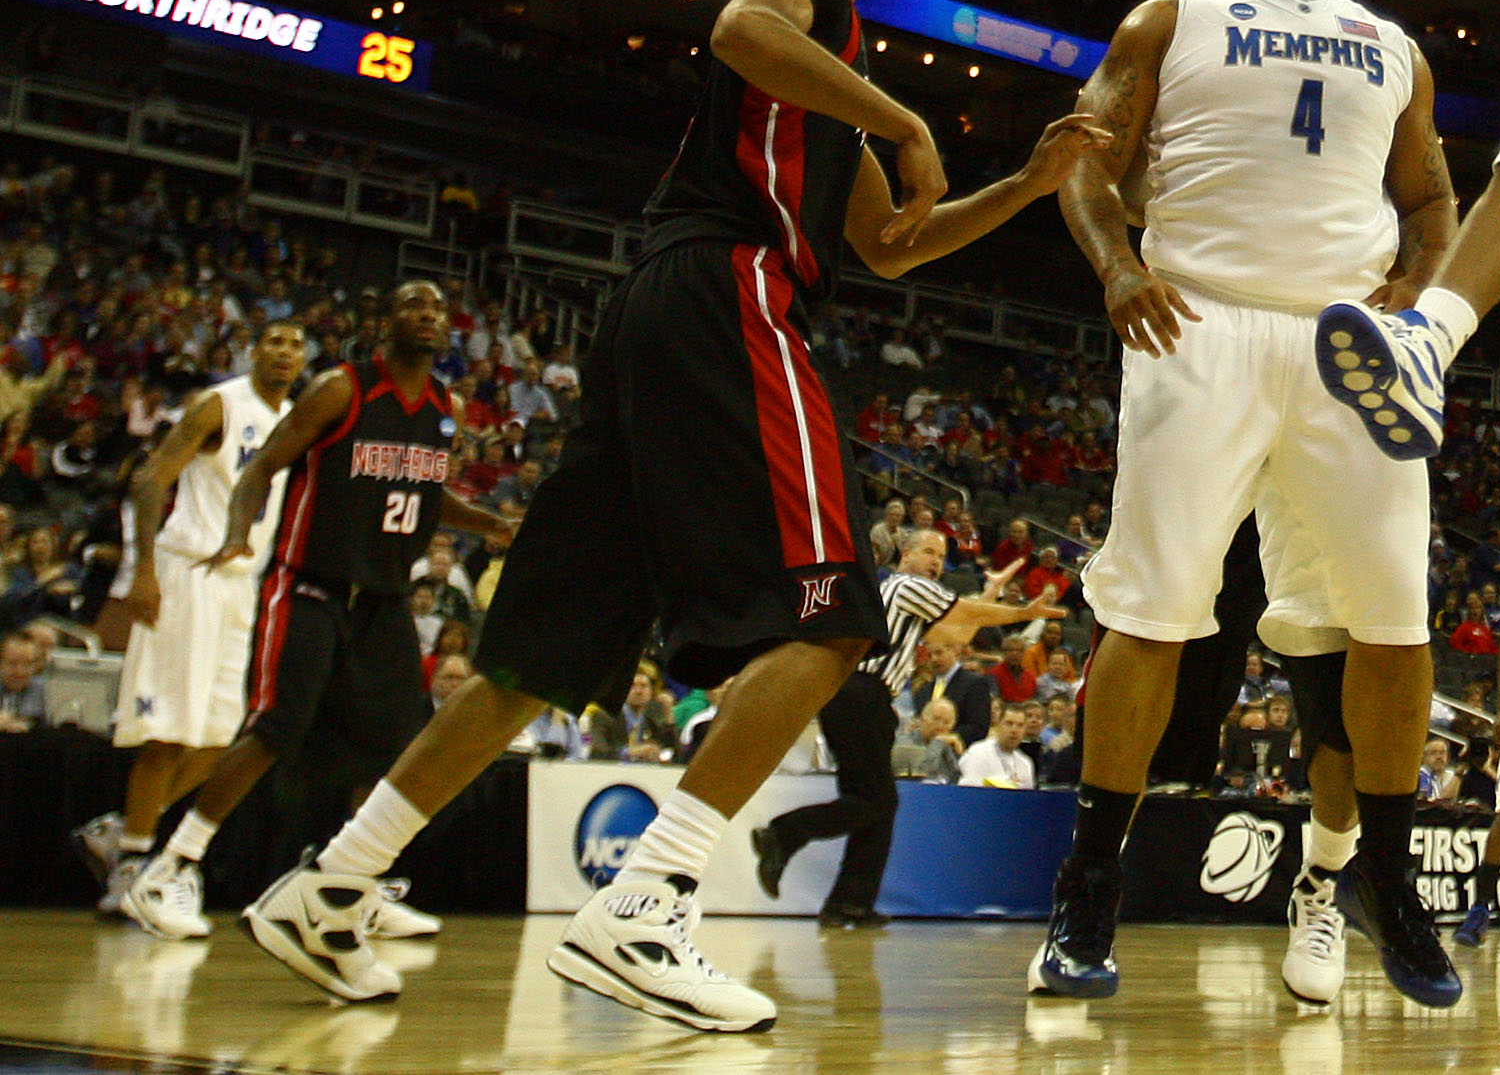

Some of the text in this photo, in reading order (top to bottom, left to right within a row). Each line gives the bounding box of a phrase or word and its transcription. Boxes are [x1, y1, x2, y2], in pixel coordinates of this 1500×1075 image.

[358, 31, 416, 83] 25
[1224, 26, 1384, 87] MEMPHIS
[1290, 78, 1325, 156] 4
[349, 441, 449, 484] NORTHRIDG
[382, 490, 423, 535] 20
[1408, 826, 1490, 874] FIRST
[1415, 874, 1461, 912] BIG
